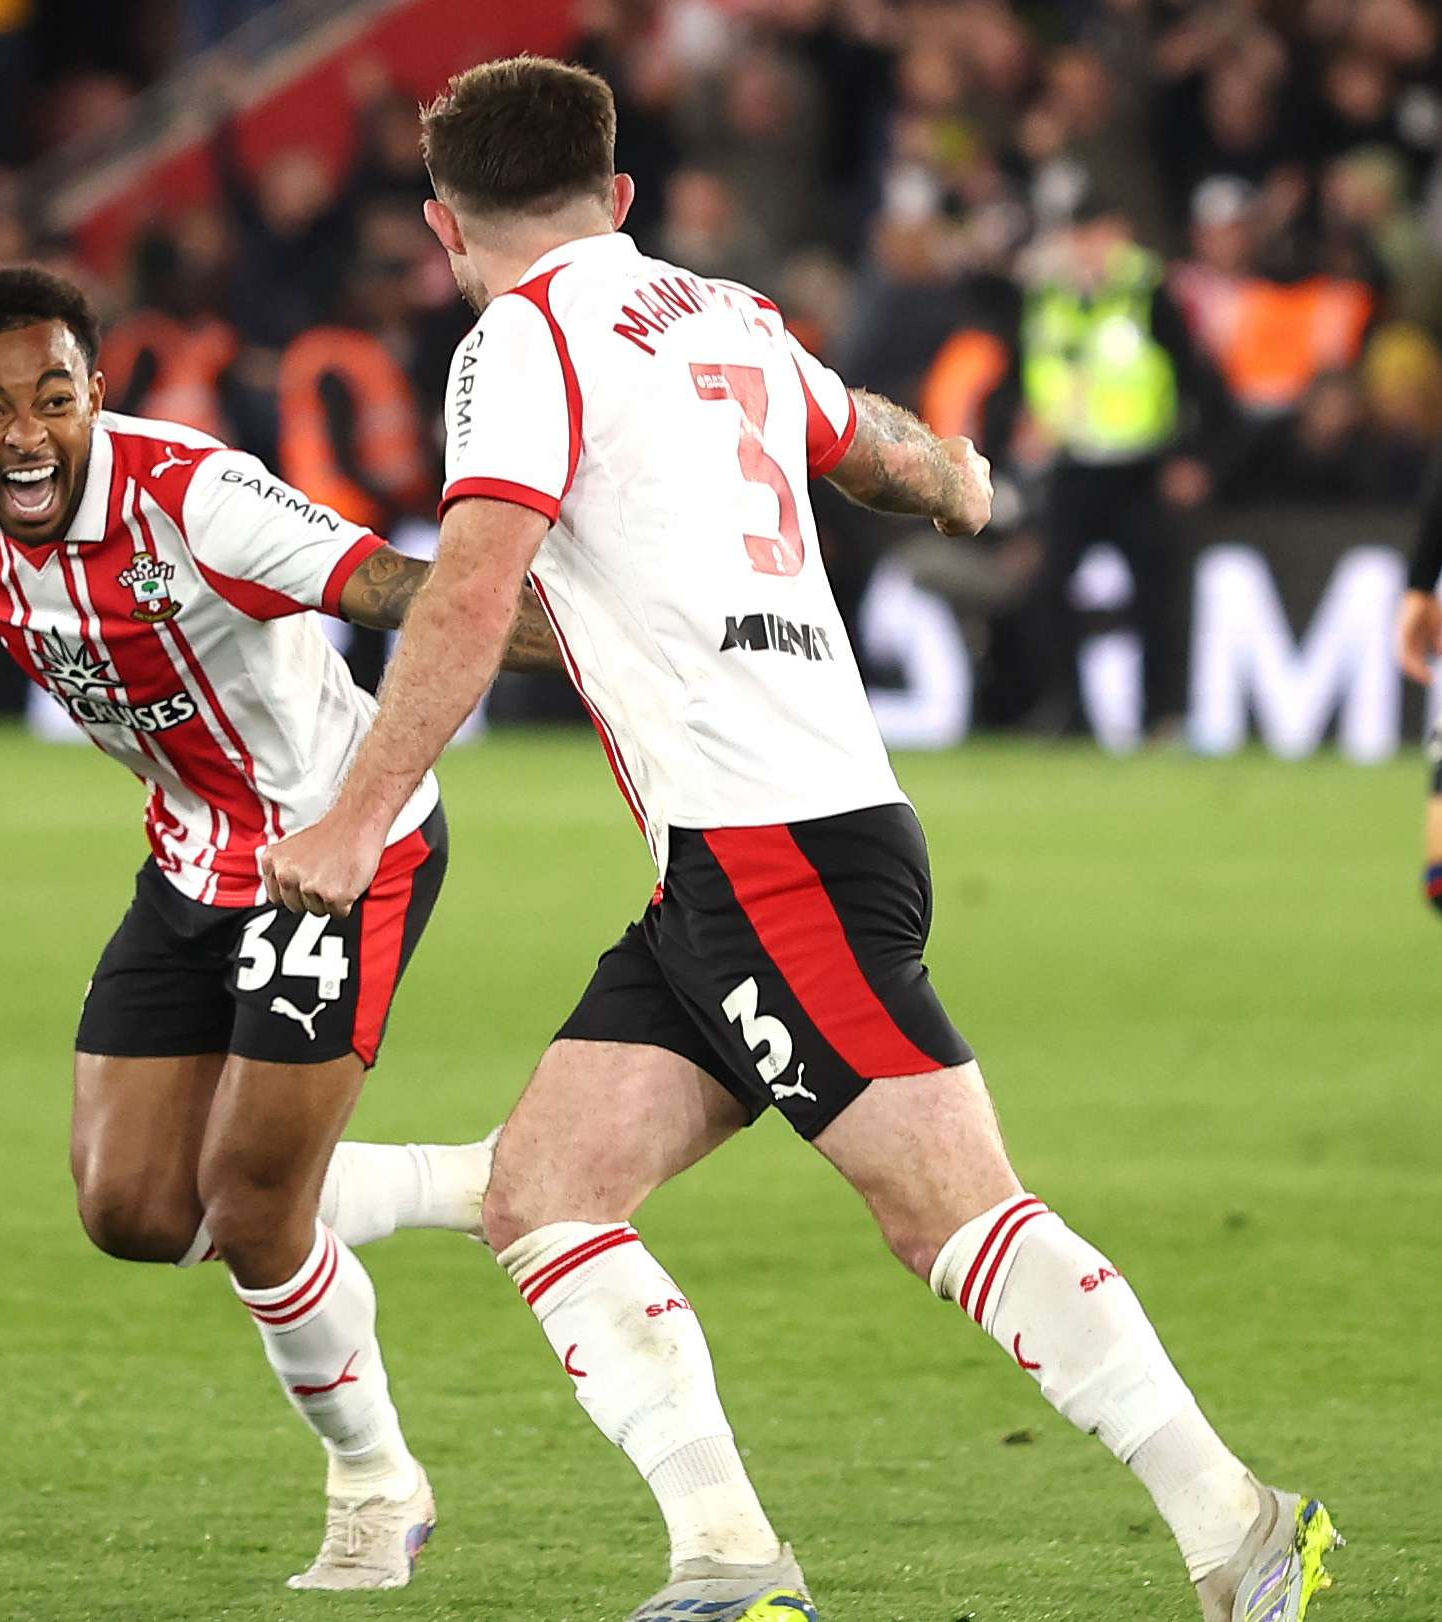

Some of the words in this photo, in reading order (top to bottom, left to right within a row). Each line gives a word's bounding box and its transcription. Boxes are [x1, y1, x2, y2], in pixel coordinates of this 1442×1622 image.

[221, 469, 338, 532] GARMIN
[689, 363, 805, 577] 3
[237, 908, 350, 1000] 34
[721, 975, 793, 1084] 3
